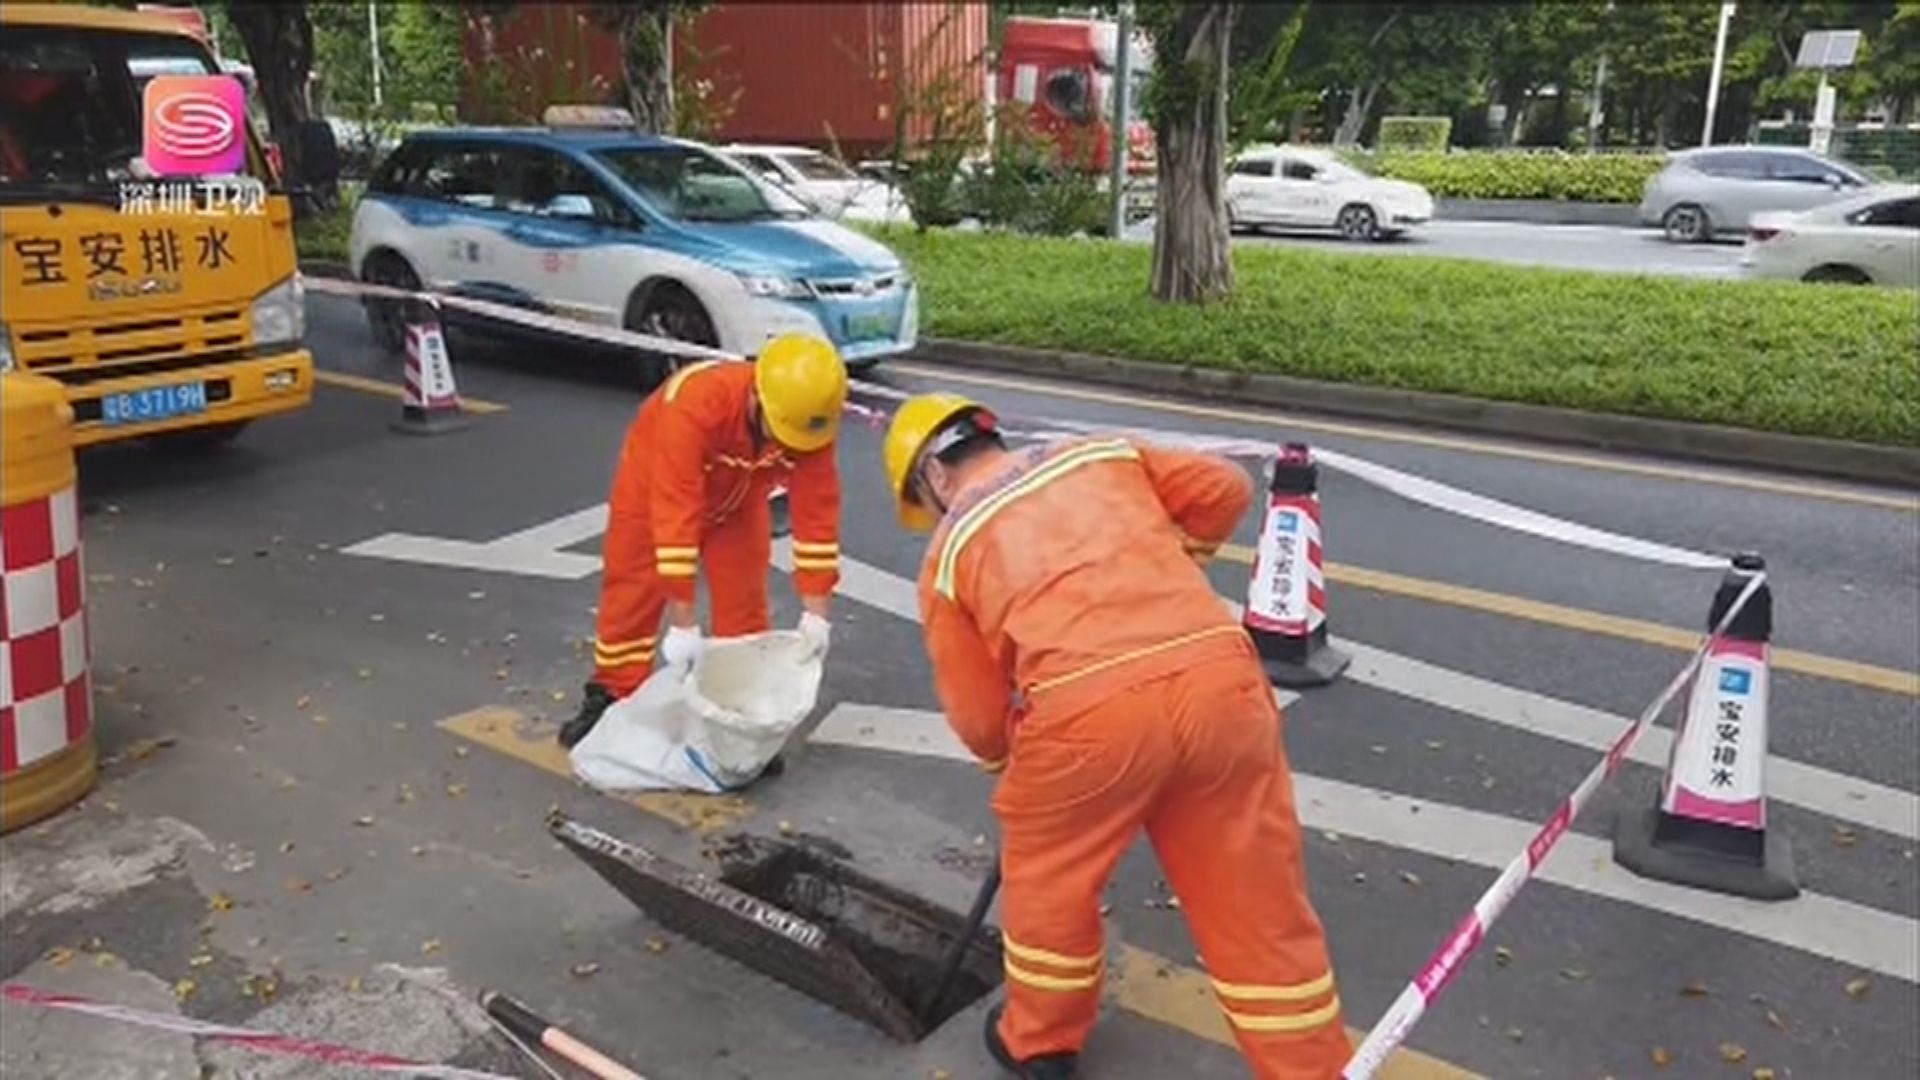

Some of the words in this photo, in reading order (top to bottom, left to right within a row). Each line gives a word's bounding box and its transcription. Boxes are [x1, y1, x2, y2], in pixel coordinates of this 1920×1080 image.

[14, 225, 236, 286] 宝安排水
[1709, 700, 1744, 788] 宝安排水
